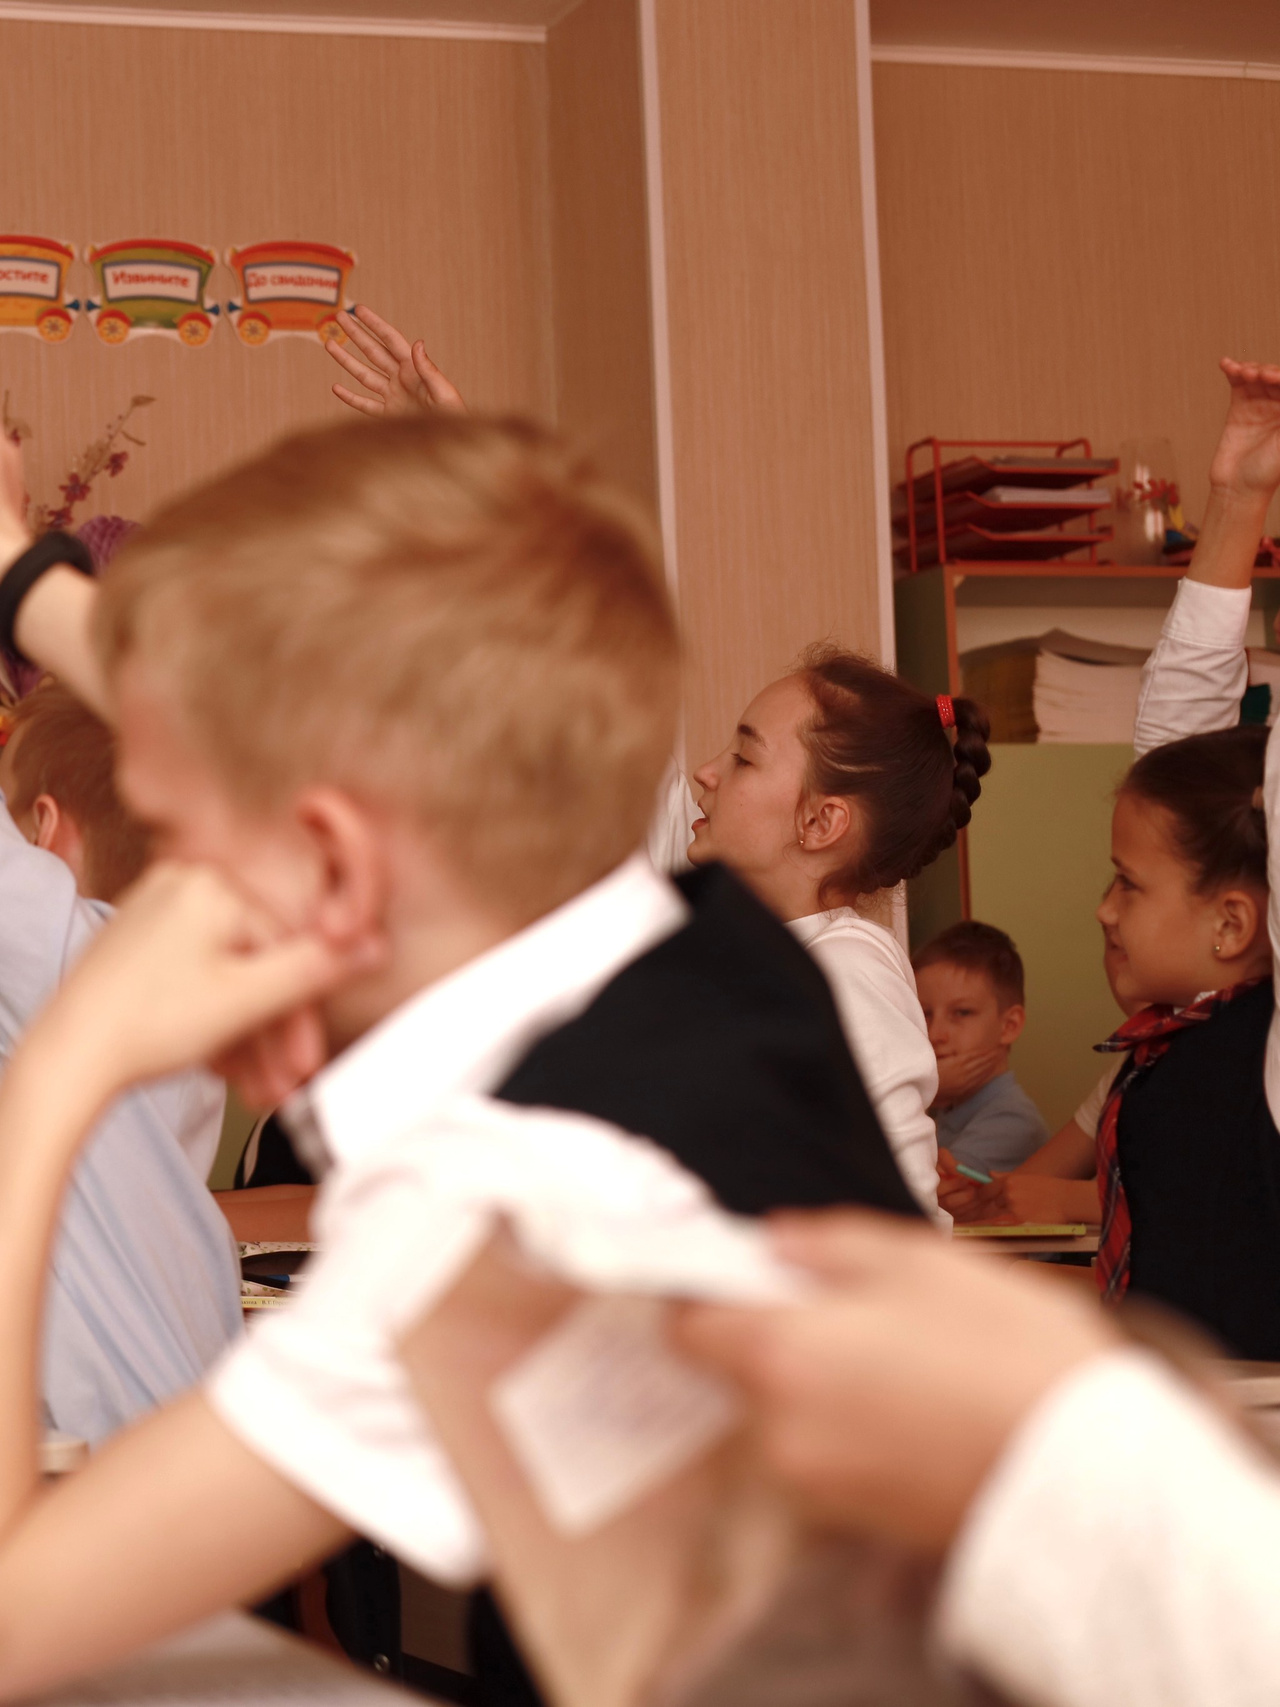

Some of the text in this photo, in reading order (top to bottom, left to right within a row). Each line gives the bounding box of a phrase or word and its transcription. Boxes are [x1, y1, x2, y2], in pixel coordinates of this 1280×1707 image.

[112, 266, 190, 288] Извините
[247, 272, 340, 290] До свидания
